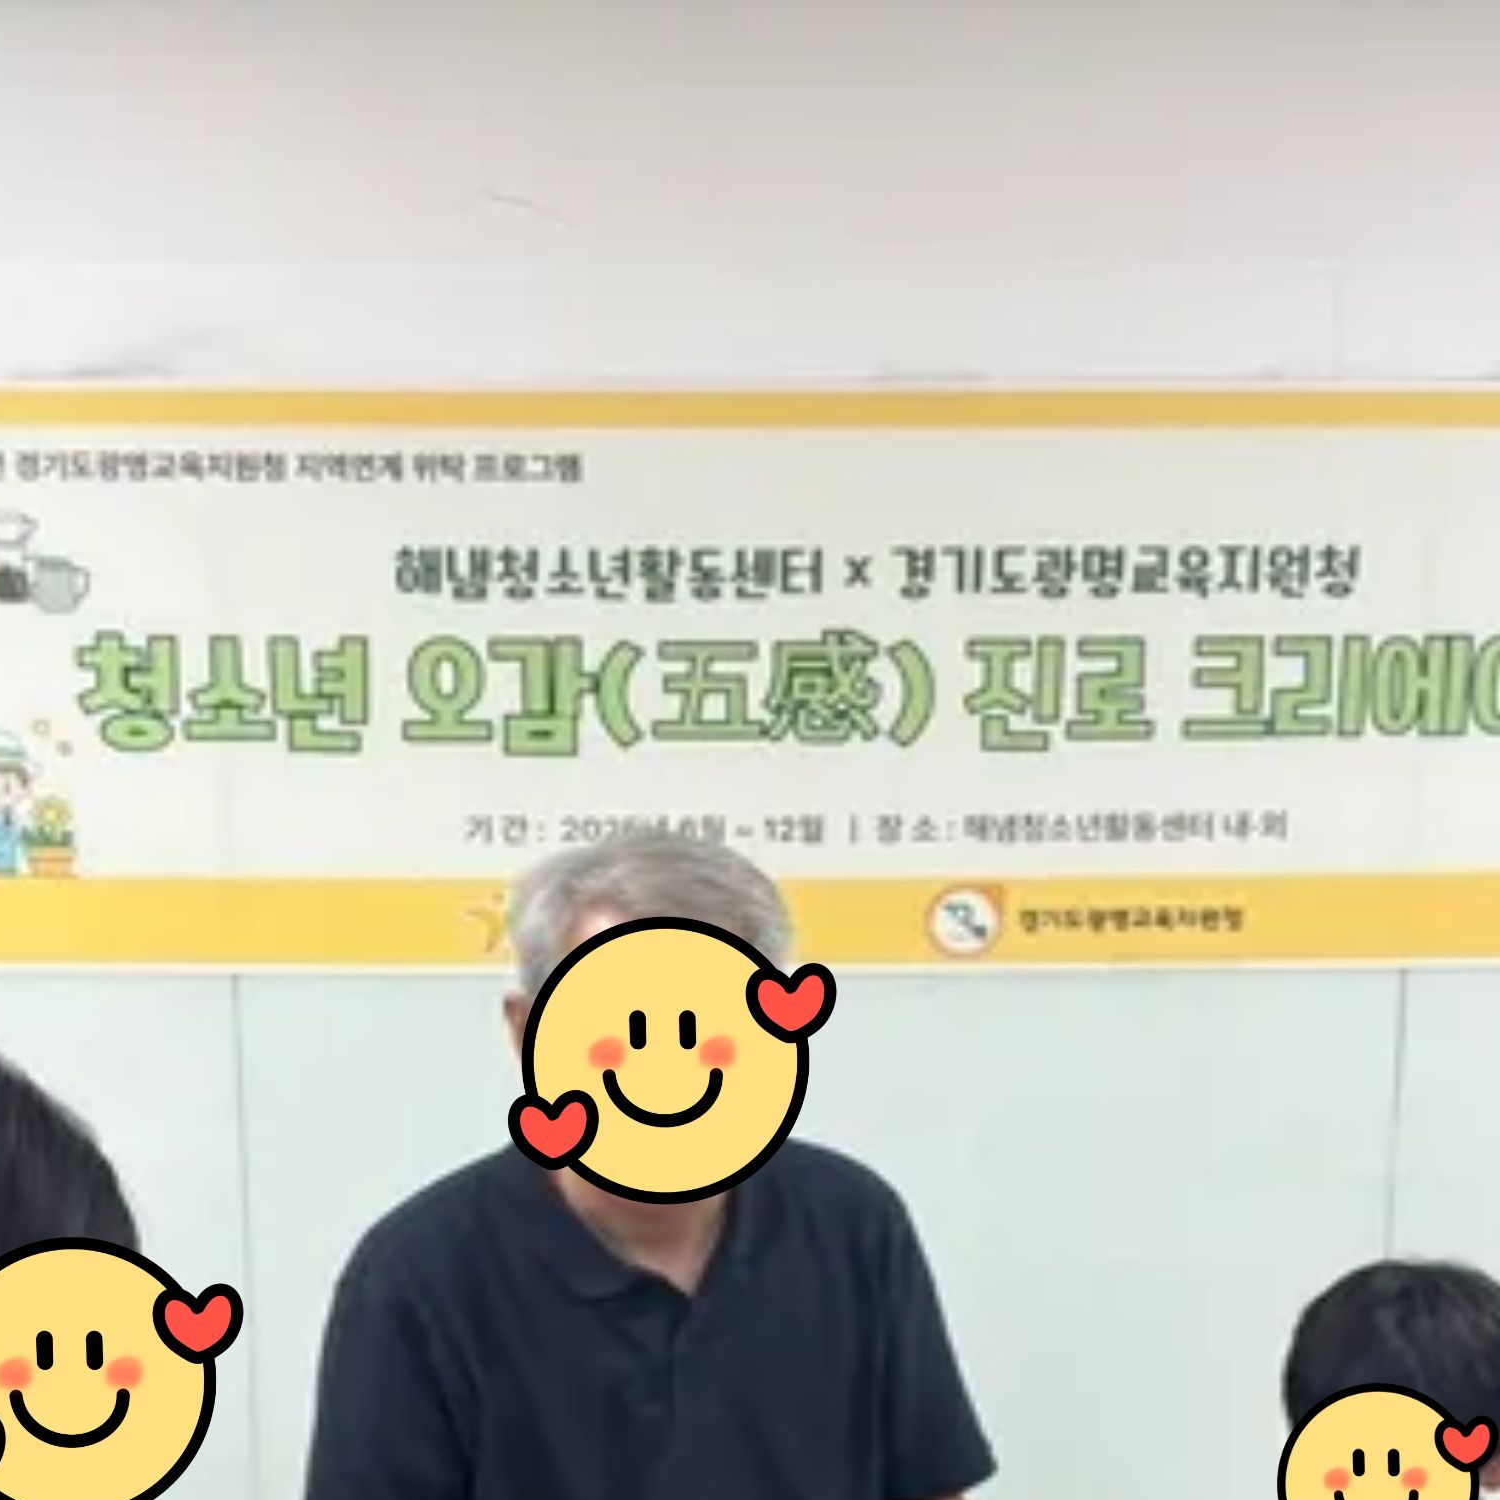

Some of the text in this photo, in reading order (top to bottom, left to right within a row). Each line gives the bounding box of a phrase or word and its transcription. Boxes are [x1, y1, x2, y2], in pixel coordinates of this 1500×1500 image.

[15, 451, 287, 483] 경기도광명교육지원청
[295, 451, 403, 483] 지역연계
[412, 453, 467, 484] 위탁
[474, 453, 582, 484] 프로그램
[396, 545, 825, 601] 해냄청소년활동센터
[891, 543, 1363, 600] 경기도광명교육지원청
[74, 628, 371, 753] 청소년
[400, 627, 938, 758] 오감(五感)
[963, 633, 1156, 754] 진로
[763, 814, 825, 844] 12월
[963, 811, 1215, 844] 해냄청소년활동센터
